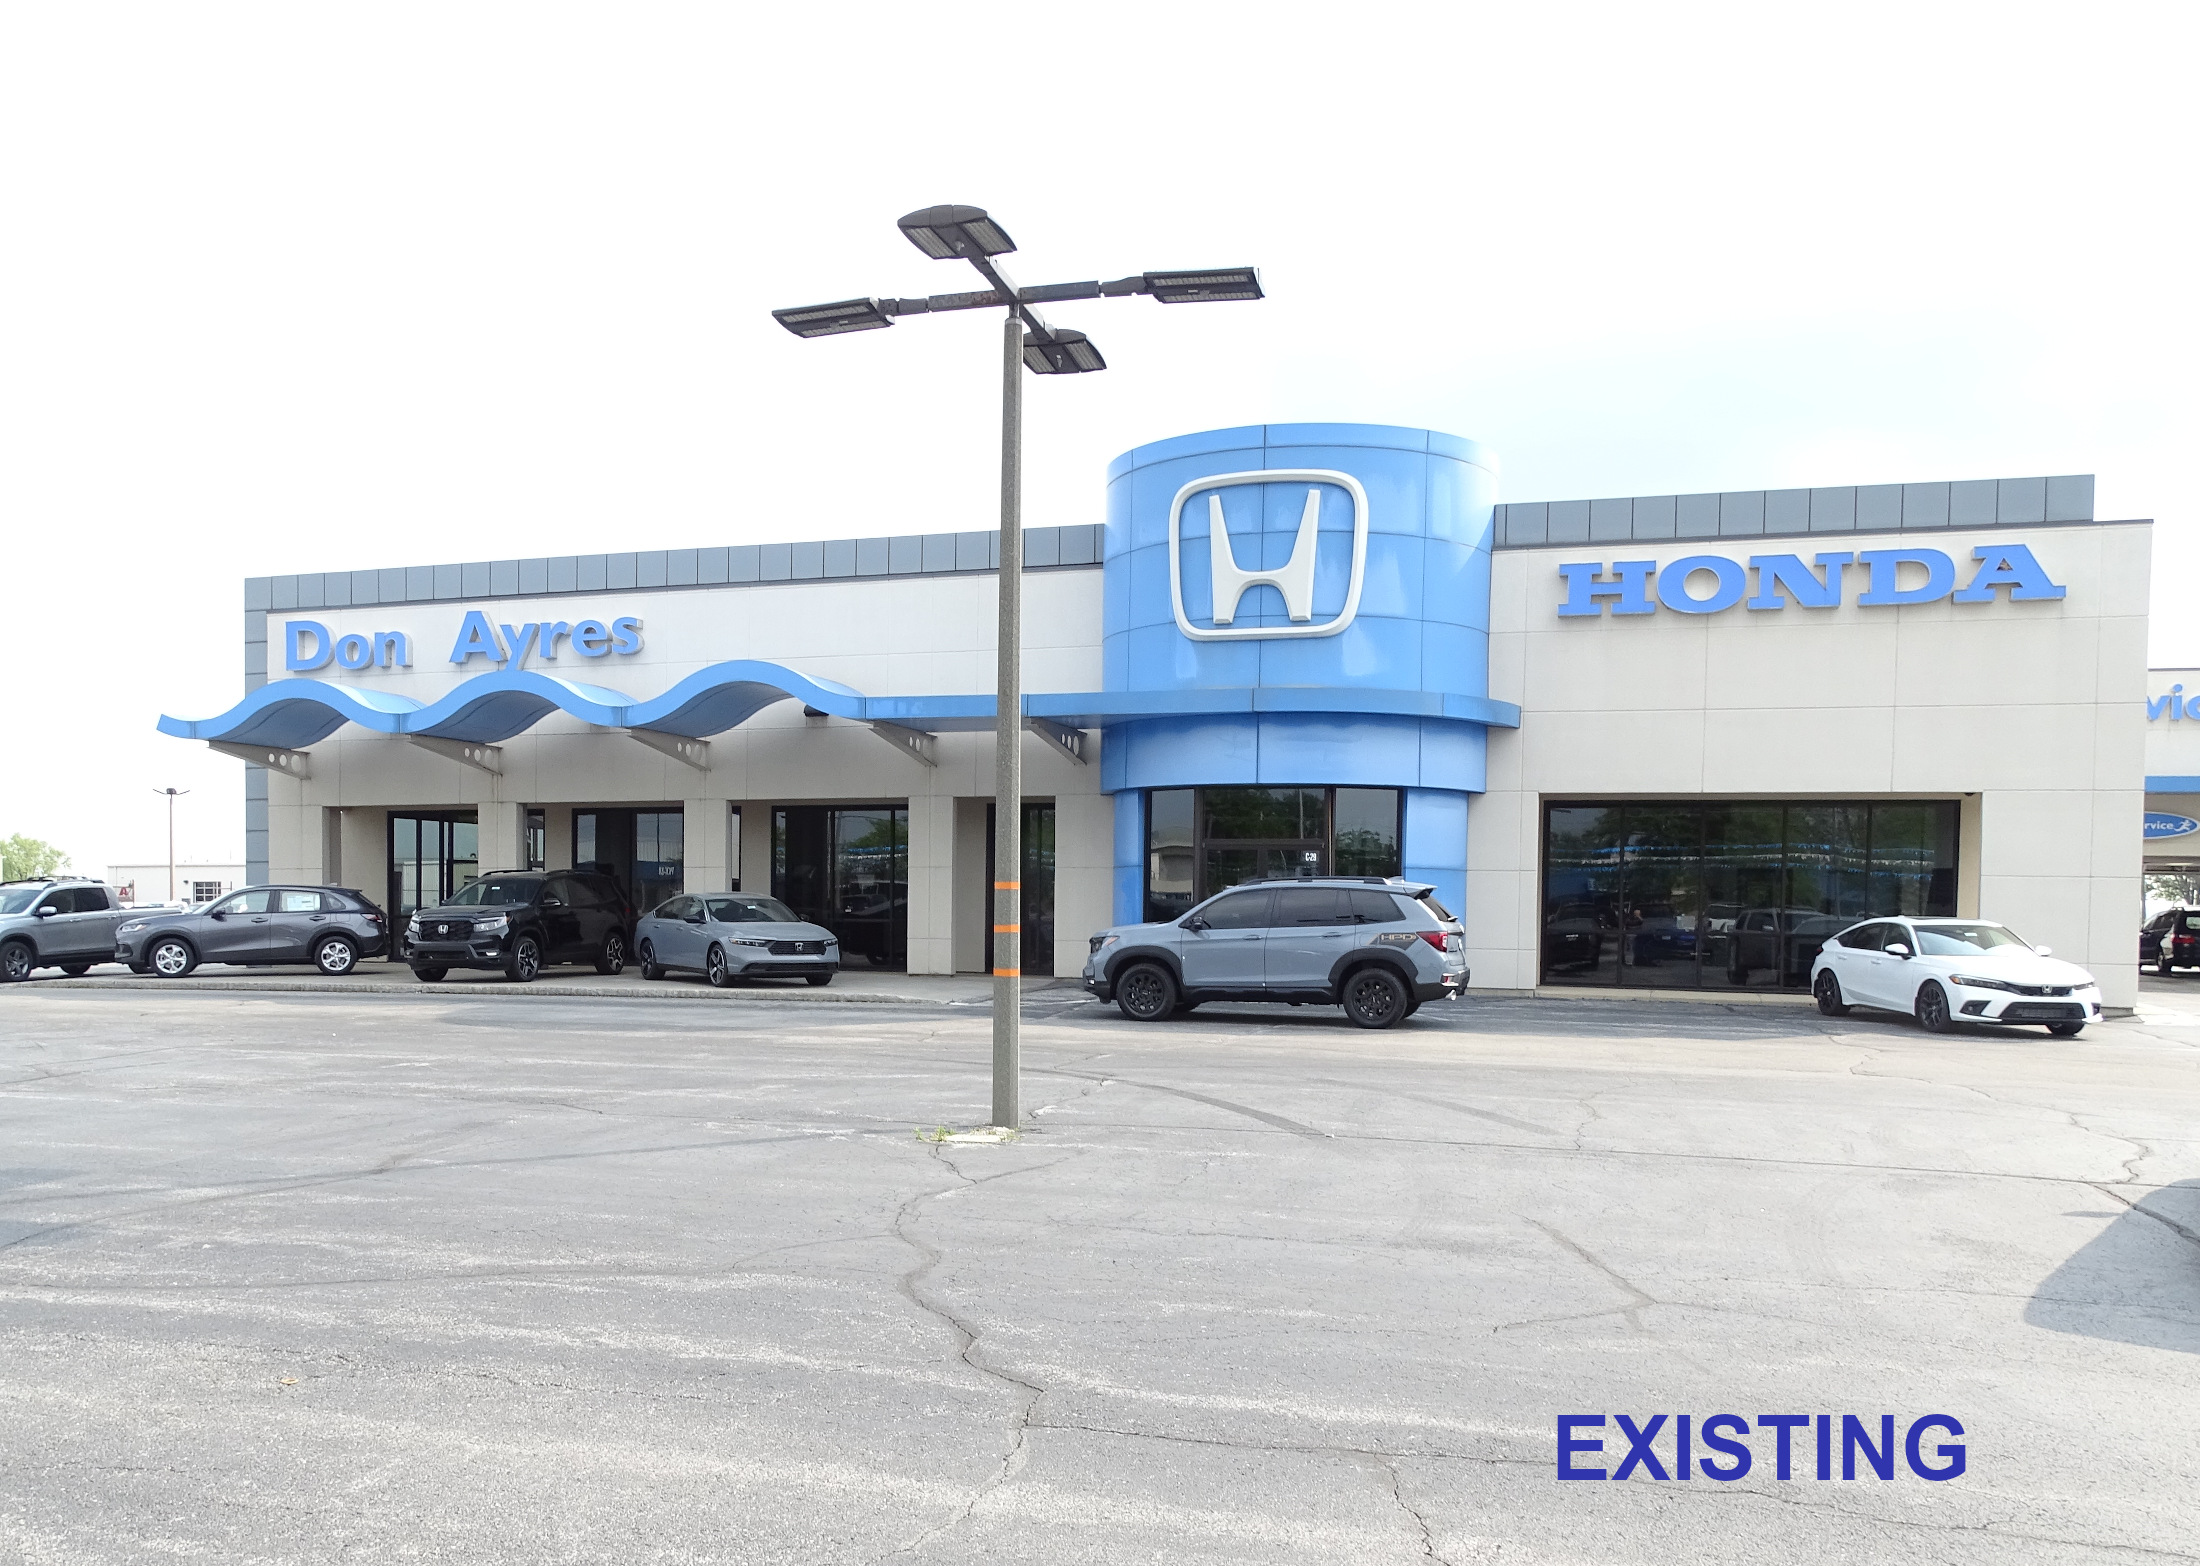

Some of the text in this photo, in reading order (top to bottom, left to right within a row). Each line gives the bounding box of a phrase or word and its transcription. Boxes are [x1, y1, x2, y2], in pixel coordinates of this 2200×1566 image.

[1558, 543, 2067, 617] HONDA
[285, 610, 644, 672] Don Ayres
[1380, 933, 1414, 941] HPD
